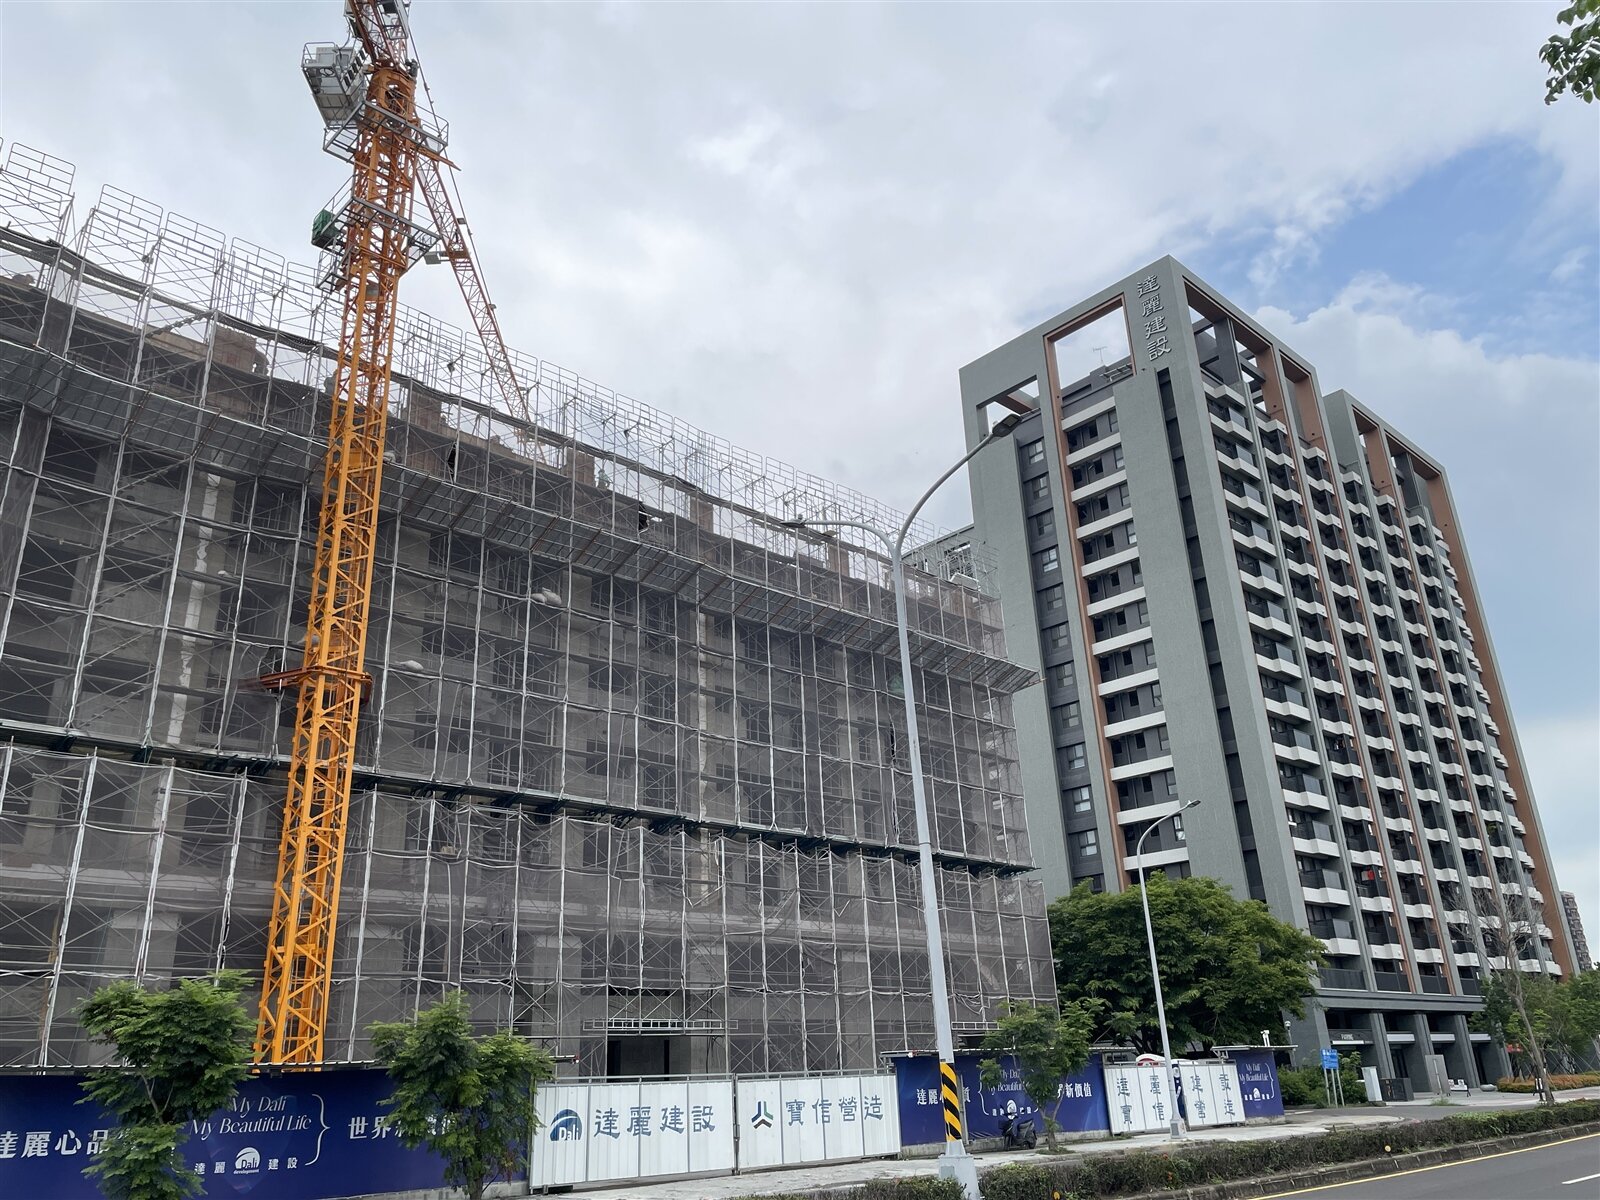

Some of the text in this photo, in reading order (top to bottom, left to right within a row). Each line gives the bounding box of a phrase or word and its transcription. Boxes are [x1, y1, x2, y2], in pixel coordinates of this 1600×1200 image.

[1136, 274, 1172, 361] 達麗建設
[257, 1095, 287, 1113] Dali
[785, 1094, 884, 1127] 寶信營造
[189, 1114, 312, 1141] My Beautiful Life
[593, 1104, 716, 1140] 達麗建設
